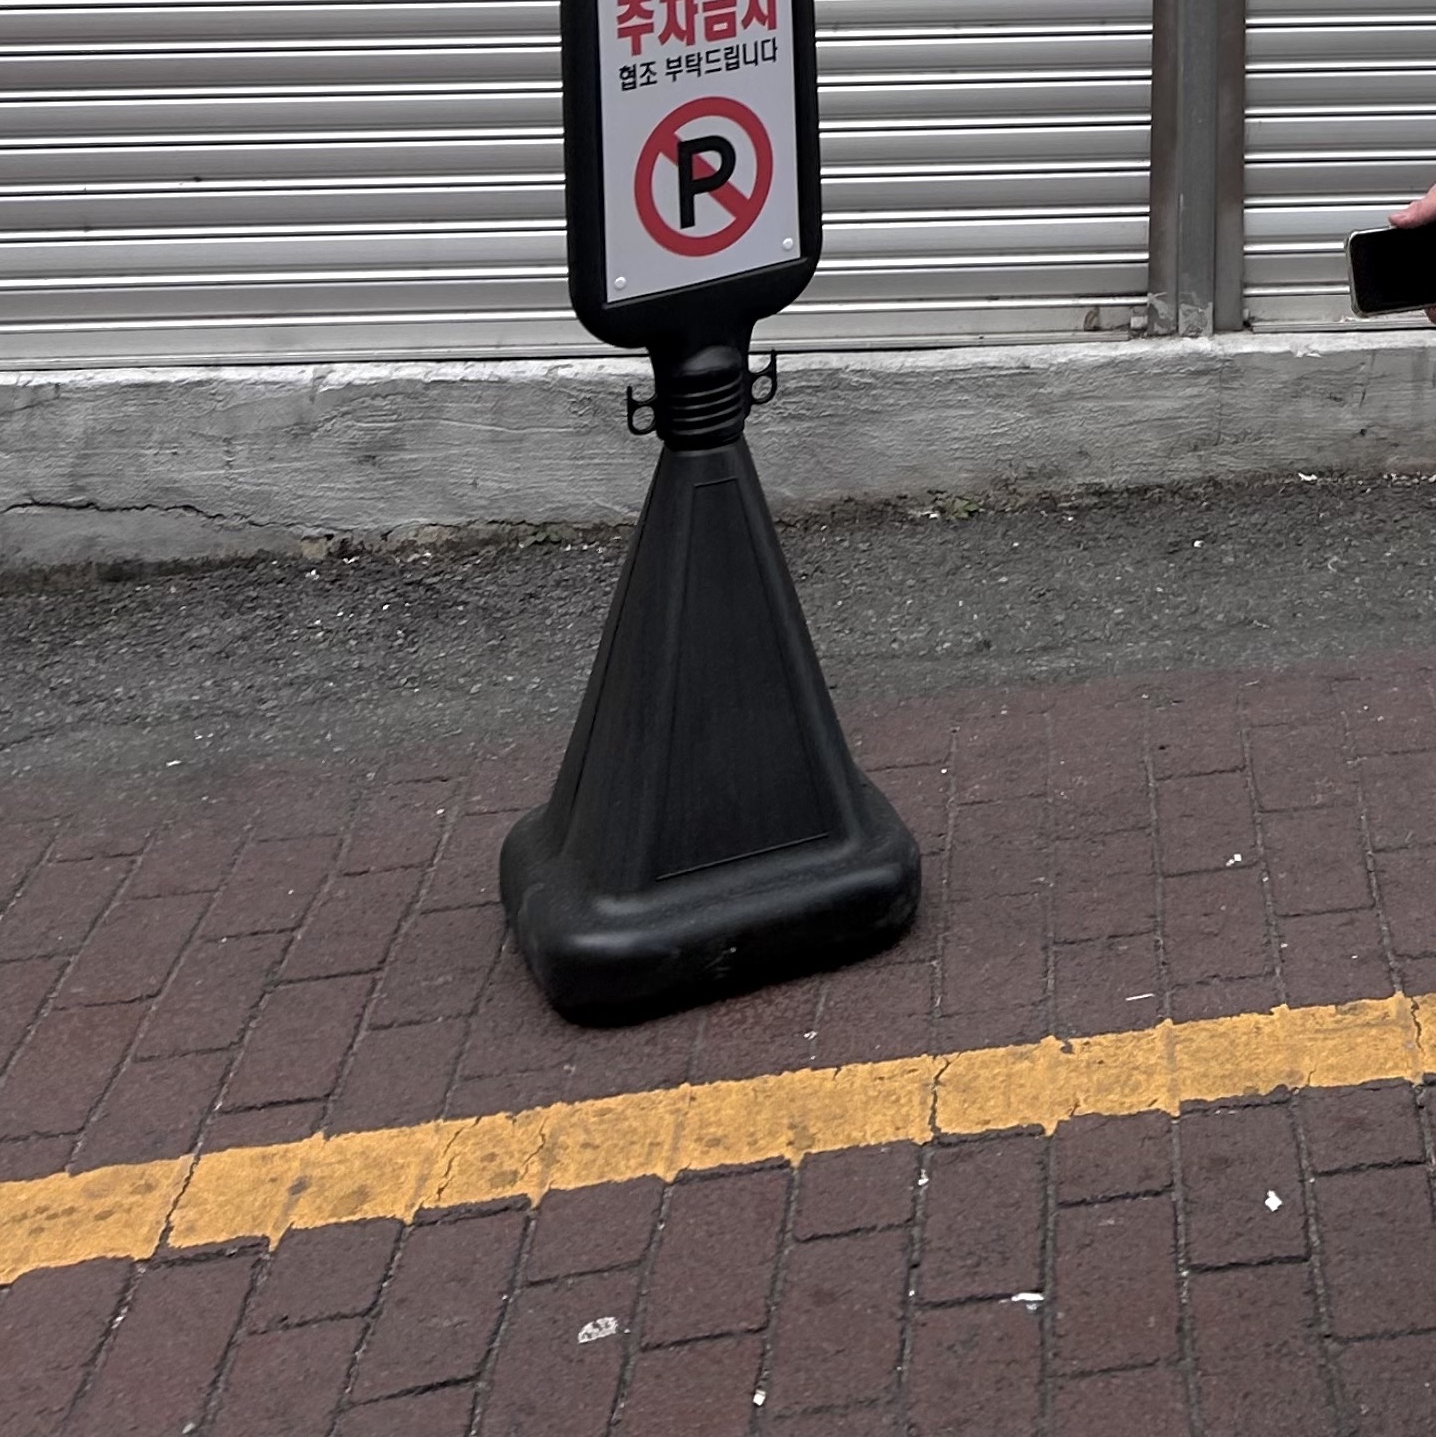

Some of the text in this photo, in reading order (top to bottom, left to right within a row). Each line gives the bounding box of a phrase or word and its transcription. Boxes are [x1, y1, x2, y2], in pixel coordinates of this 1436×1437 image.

[618, 37, 778, 92] 협조 부탁드립니다
[677, 134, 737, 230] P
